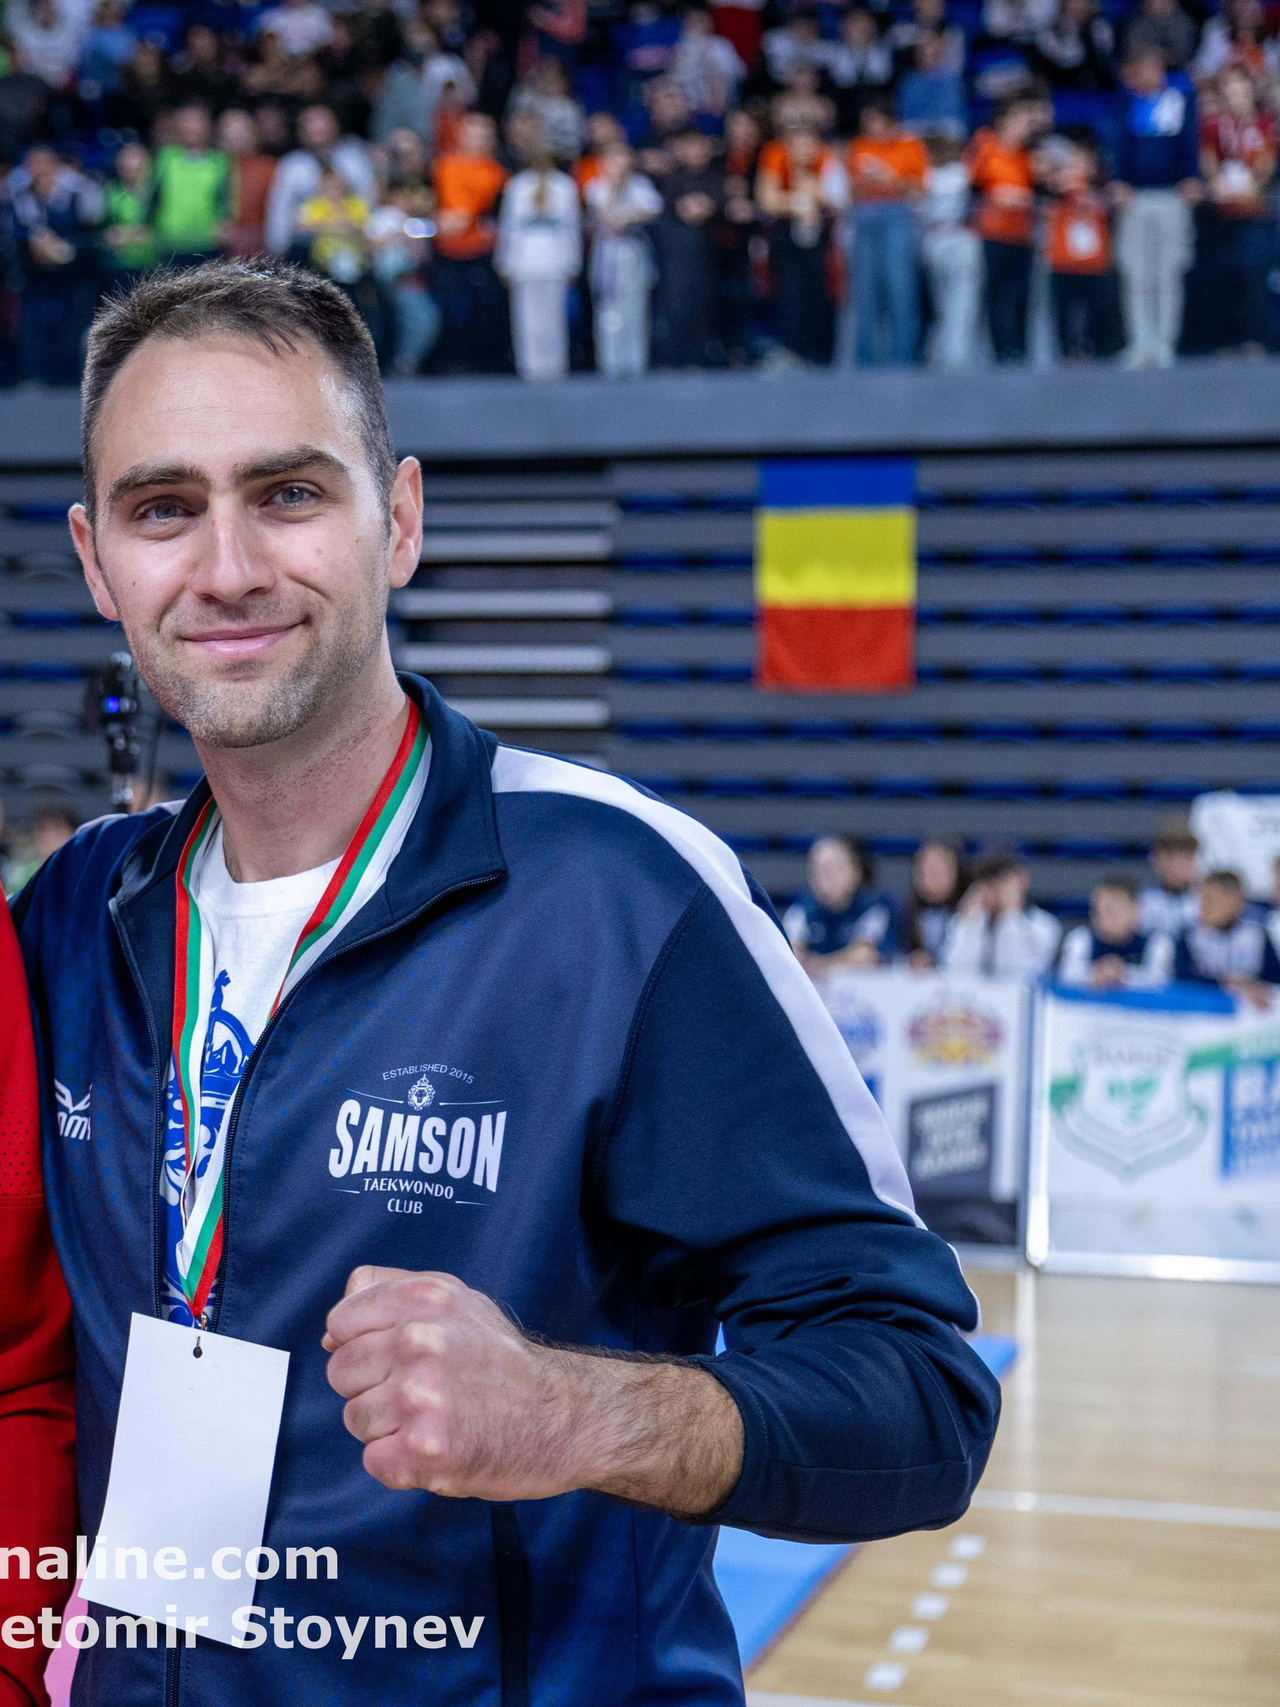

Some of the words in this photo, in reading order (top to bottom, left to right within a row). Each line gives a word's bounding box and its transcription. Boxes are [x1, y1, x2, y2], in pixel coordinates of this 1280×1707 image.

[382, 1063, 448, 1081] ESTABLISHED
[449, 1066, 474, 1084] 2015
[328, 1099, 507, 1193] SAMSON
[363, 1177, 454, 1200] TAEKWONDO
[387, 1198, 423, 1214] CLUB
